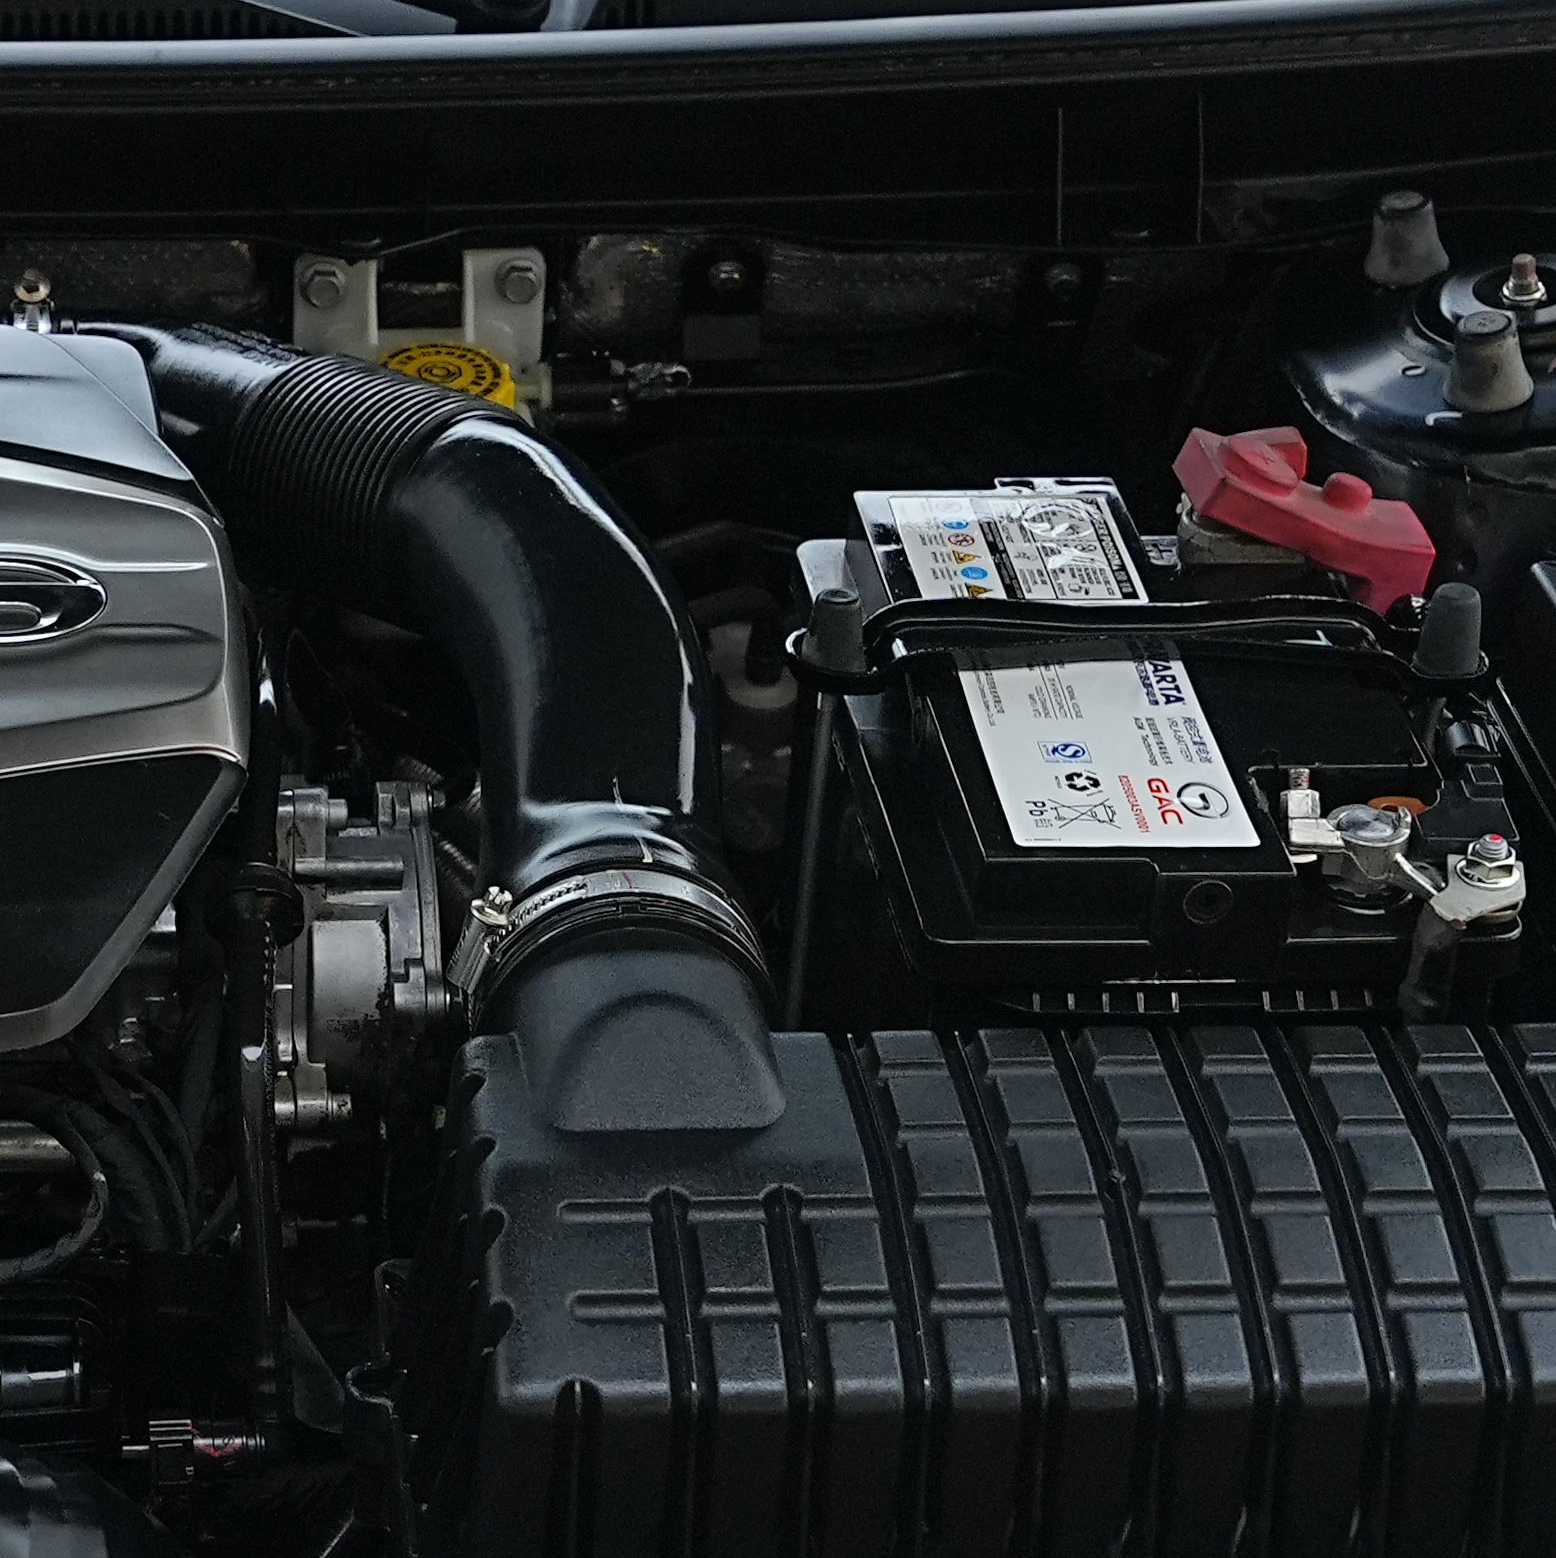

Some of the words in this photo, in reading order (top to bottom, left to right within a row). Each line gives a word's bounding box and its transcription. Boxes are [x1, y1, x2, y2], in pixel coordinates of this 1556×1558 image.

[1139, 733, 1160, 766] Technology
[1024, 800, 1049, 816] Pb
[1147, 778, 1184, 824] GAC
